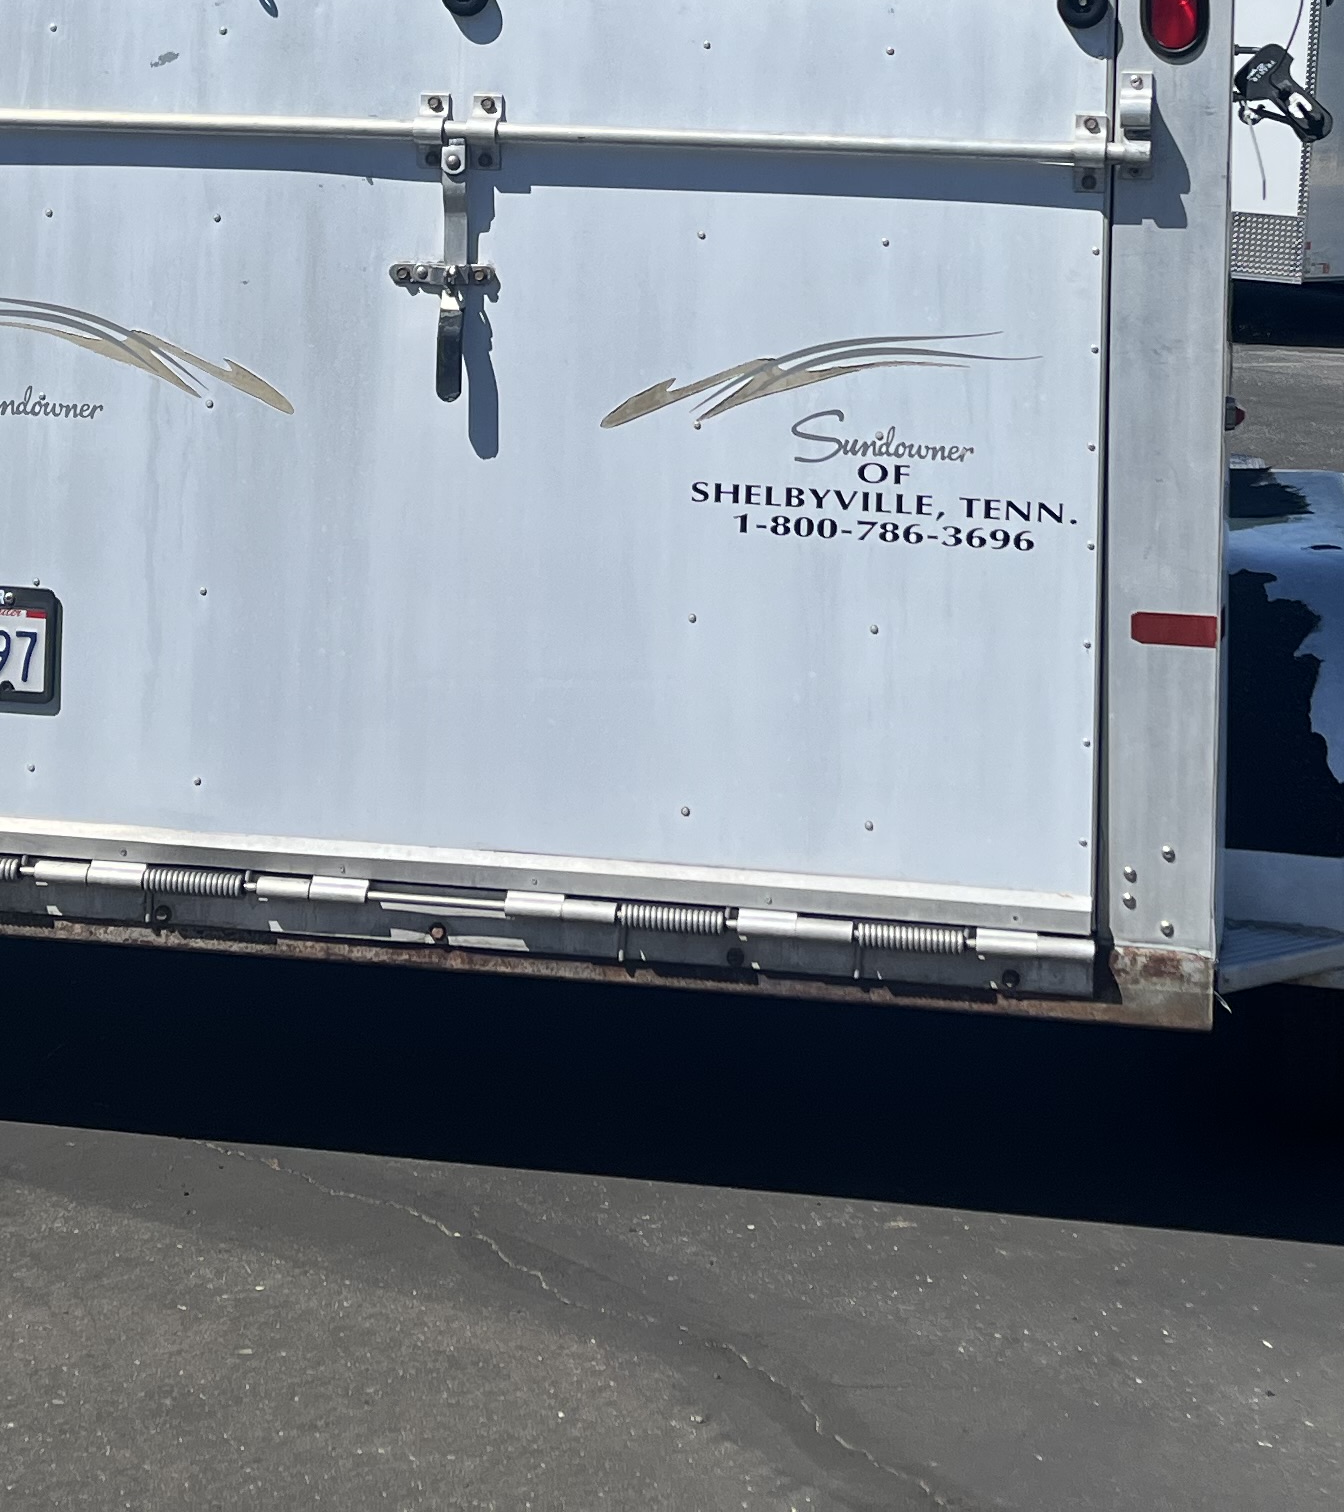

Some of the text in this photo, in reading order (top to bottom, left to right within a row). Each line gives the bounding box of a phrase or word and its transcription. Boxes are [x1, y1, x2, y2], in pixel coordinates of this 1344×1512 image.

[791, 409, 975, 463] Sundowner
[856, 462, 911, 485] OF
[690, 481, 1079, 526] SHELBYVILLE, TENN.
[733, 513, 1036, 552] 1-800-786-3696
